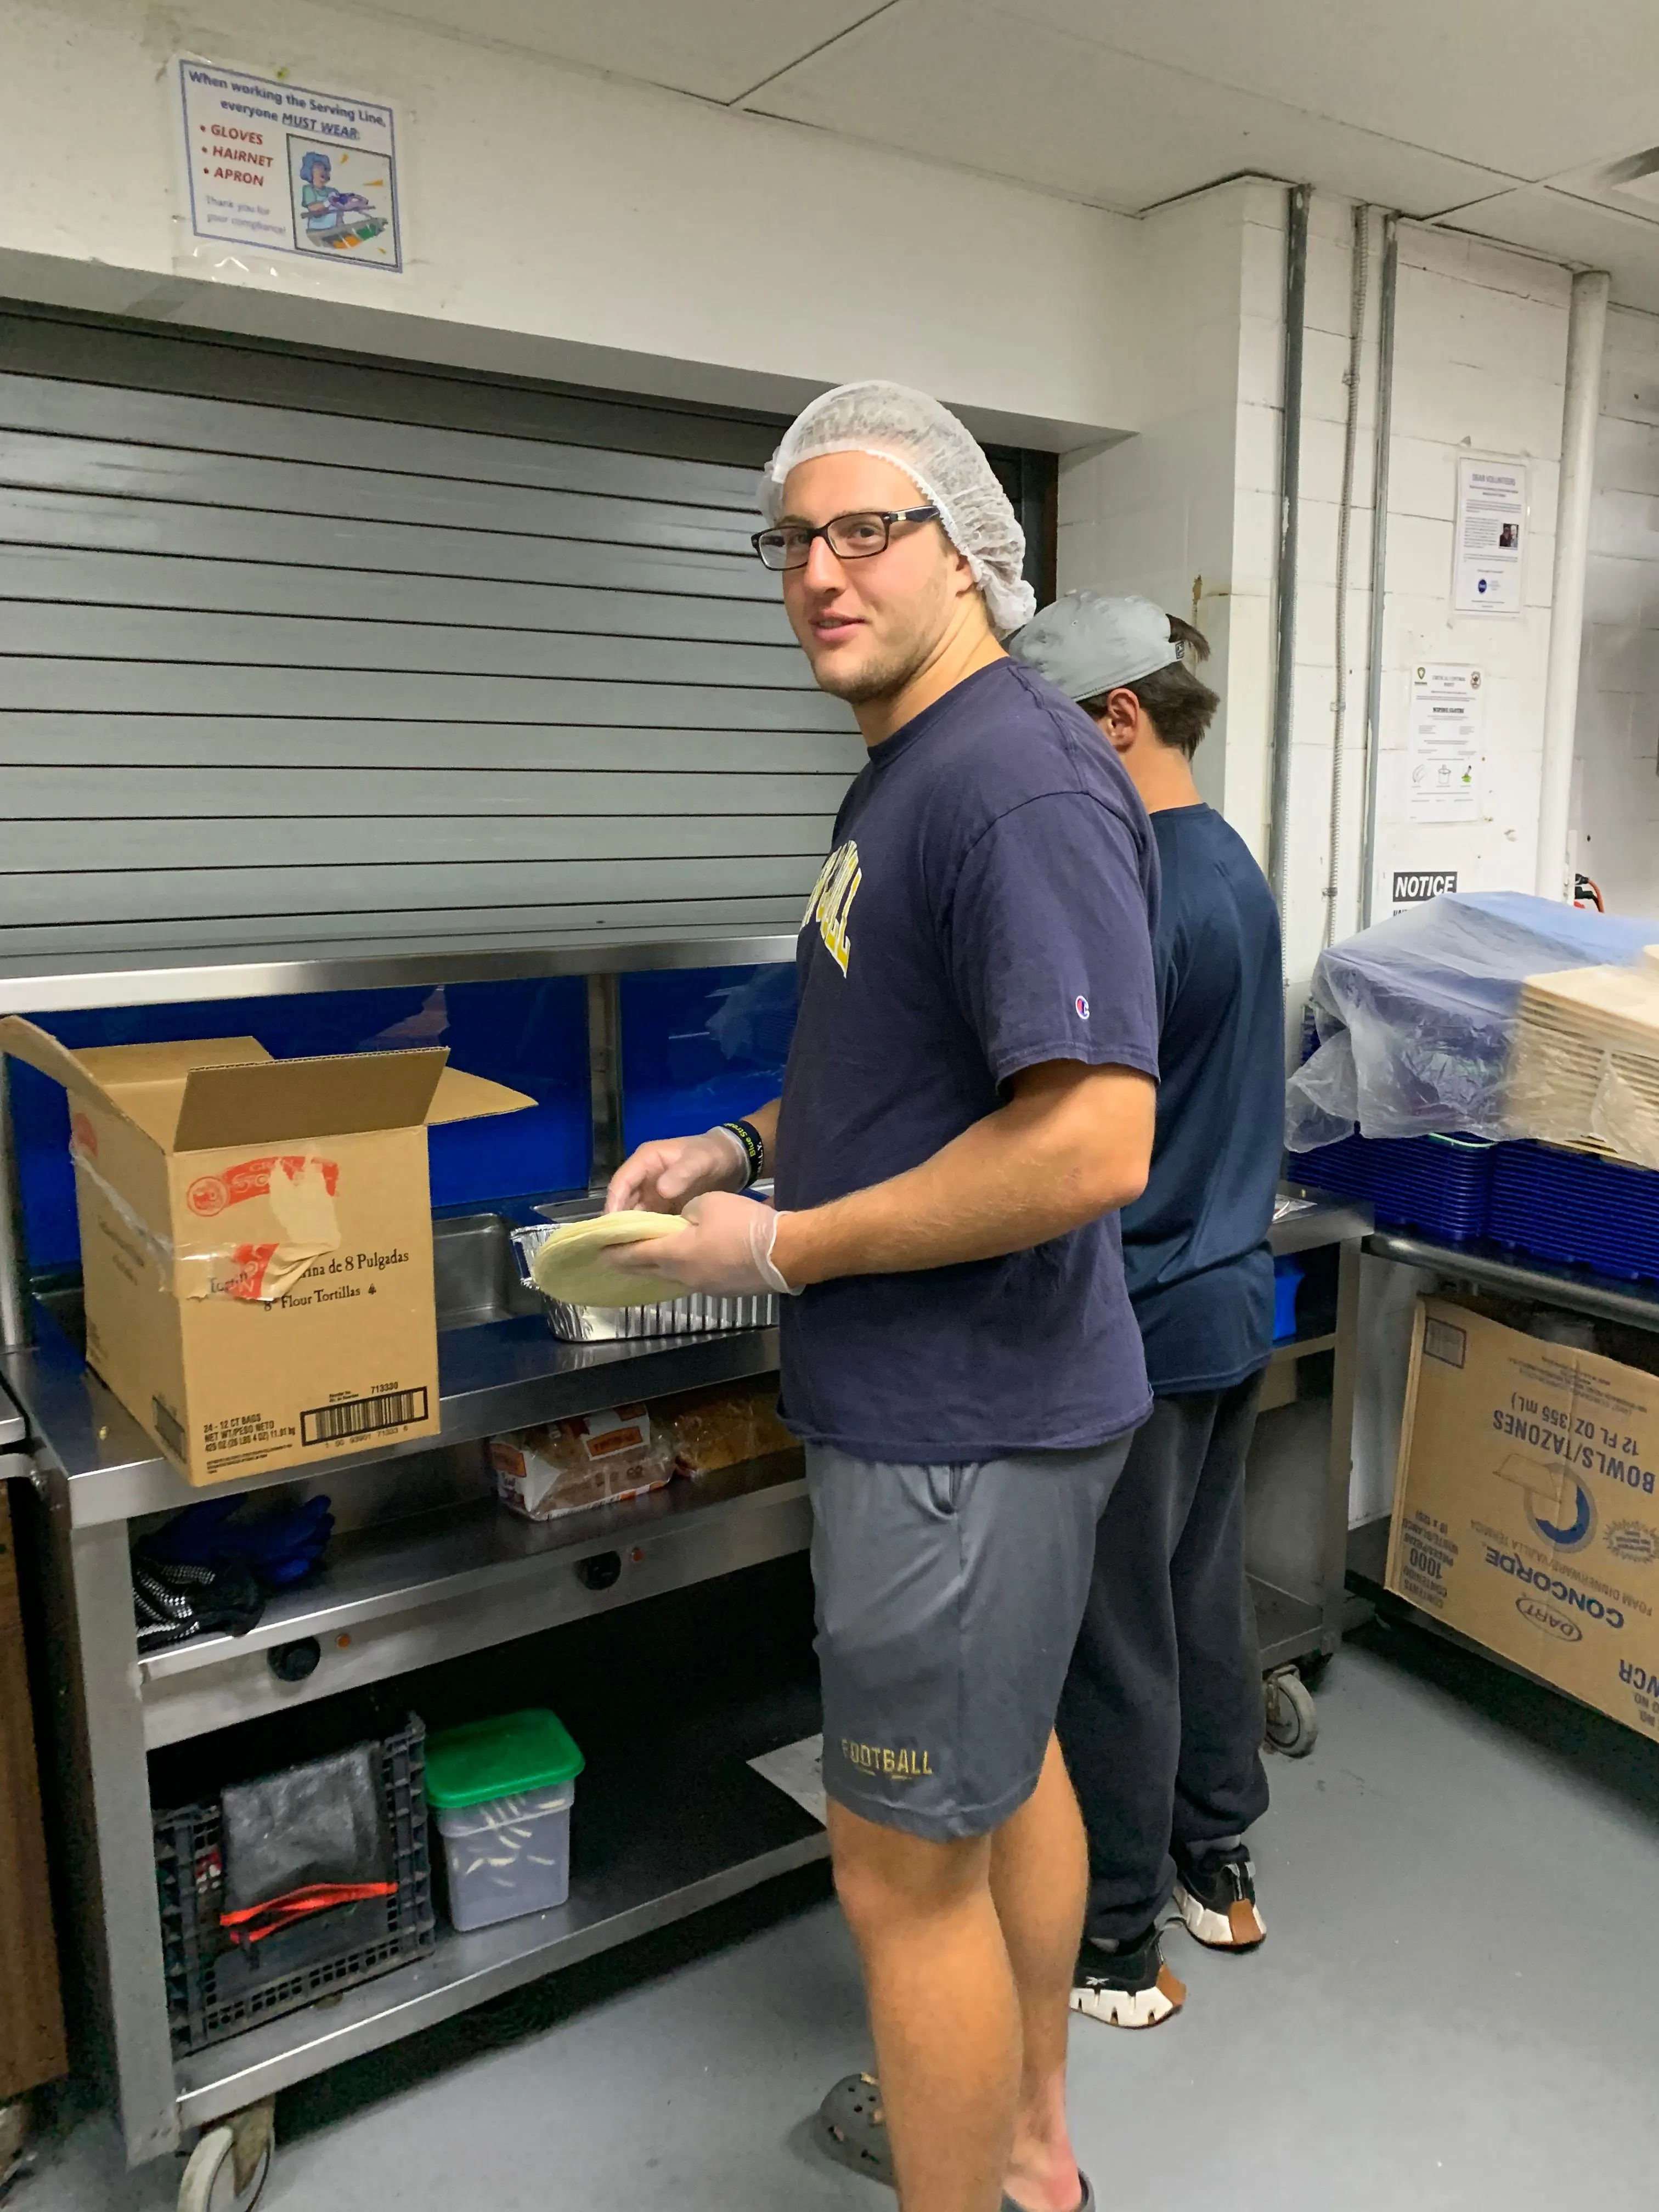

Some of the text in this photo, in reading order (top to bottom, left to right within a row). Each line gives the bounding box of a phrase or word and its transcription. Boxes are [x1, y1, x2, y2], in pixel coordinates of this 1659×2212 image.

[189, 70, 228, 88] When
[231, 82, 282, 104] working
[286, 95, 306, 109] the
[309, 99, 355, 121] Serving
[221, 99, 278, 121] everyone
[282, 112, 317, 130] MUST
[211, 124, 263, 145] GLOVES
[212, 145, 273, 168] HAIRNET
[215, 167, 264, 186] APRON
[206, 195, 233, 210] Thank
[237, 201, 254, 216] you
[1395, 876, 1455, 898] NOTICE
[329, 1258, 342, 1273] de
[345, 1256, 354, 1272] 8
[356, 1249, 409, 1270] Pulgadas
[281, 1295, 313, 1309] Flour
[314, 1285, 360, 1303] Tortillas
[1511, 1392, 1538, 1414] mL)
[205, 1431, 218, 1442] NET
[1574, 1418, 1595, 1440] OZ
[1600, 1426, 1618, 1449] FL
[1492, 1409, 1656, 1494] BOWLS/TAZONES
[1622, 1436, 1640, 1457] 12
[1409, 1548, 1443, 1579] 1000
[1484, 1546, 1624, 1629] CONCORDE
[1622, 1592, 1653, 1616] FOAM
[1525, 1605, 1575, 1637] DART
[842, 1738, 933, 1775] FOOTBALL
